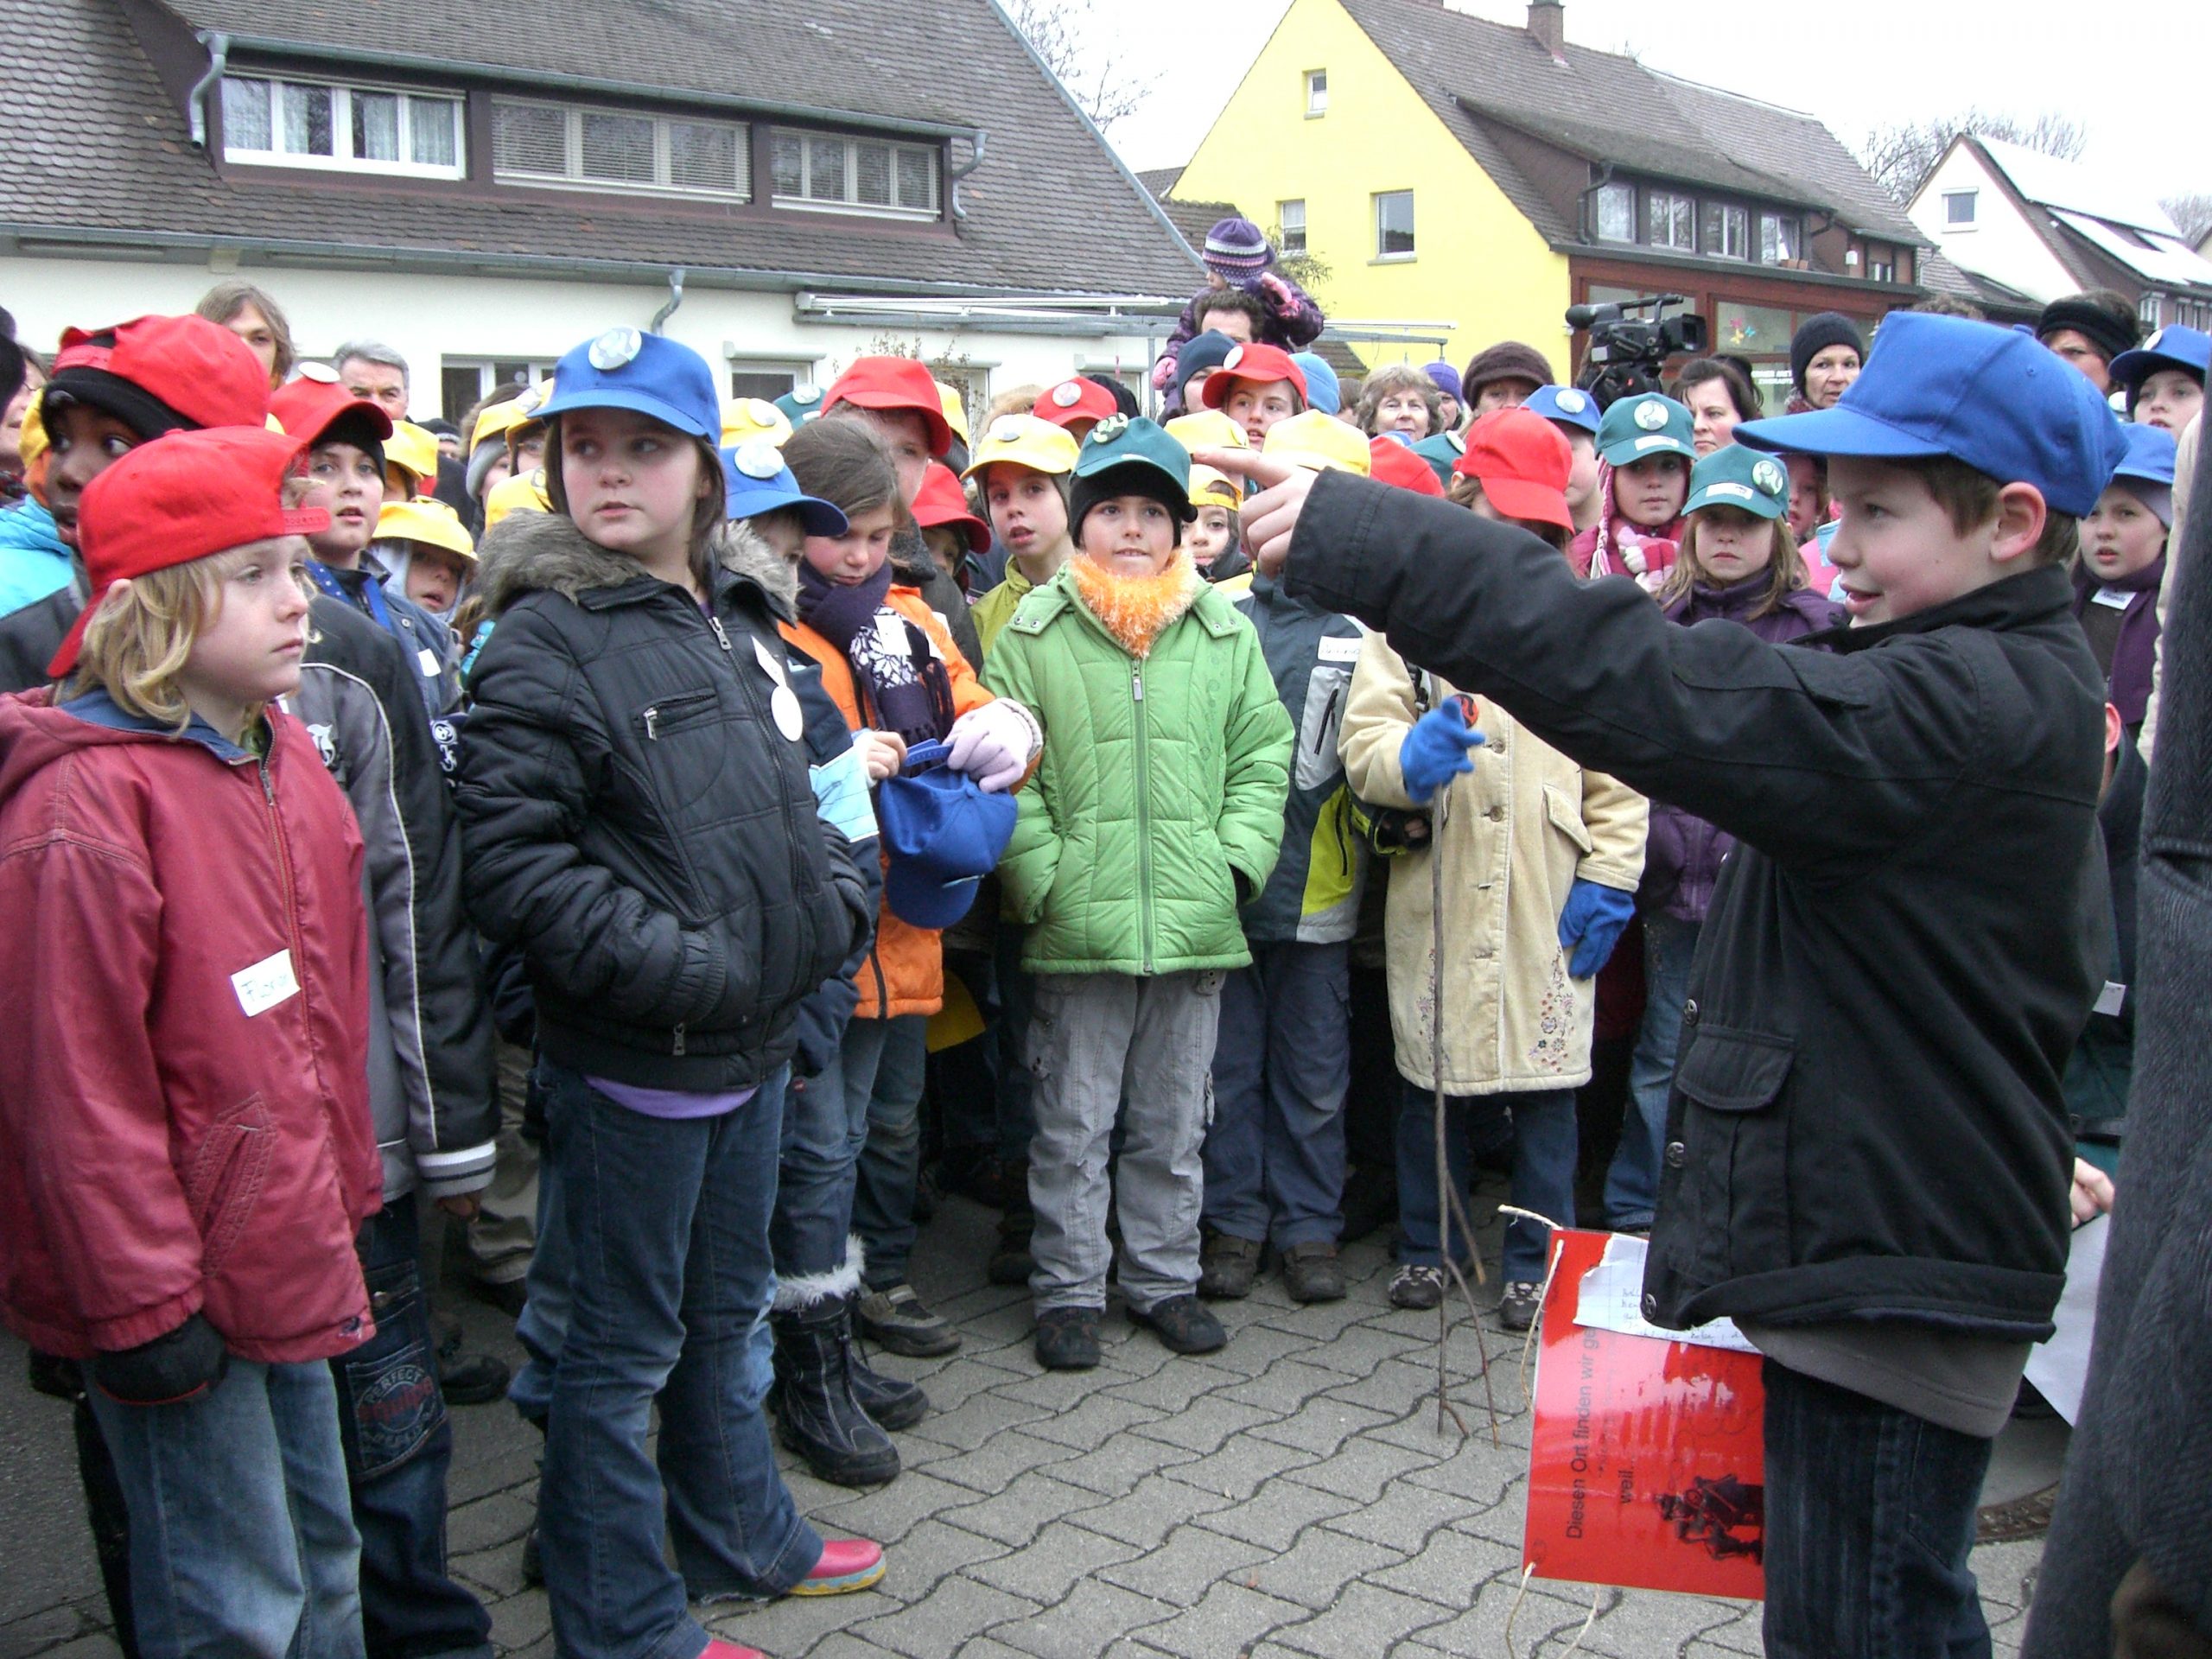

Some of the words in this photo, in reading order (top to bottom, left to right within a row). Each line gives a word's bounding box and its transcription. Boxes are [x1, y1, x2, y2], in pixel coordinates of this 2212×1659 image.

[1583, 1327, 1599, 1350] ge
[1580, 1353, 1594, 1381] wir
[365, 1367, 424, 1403] PERFECT
[1573, 1385, 1591, 1440] finden
[1571, 1445, 1588, 1473] Ort
[1566, 1478, 1586, 1539] Diesen
